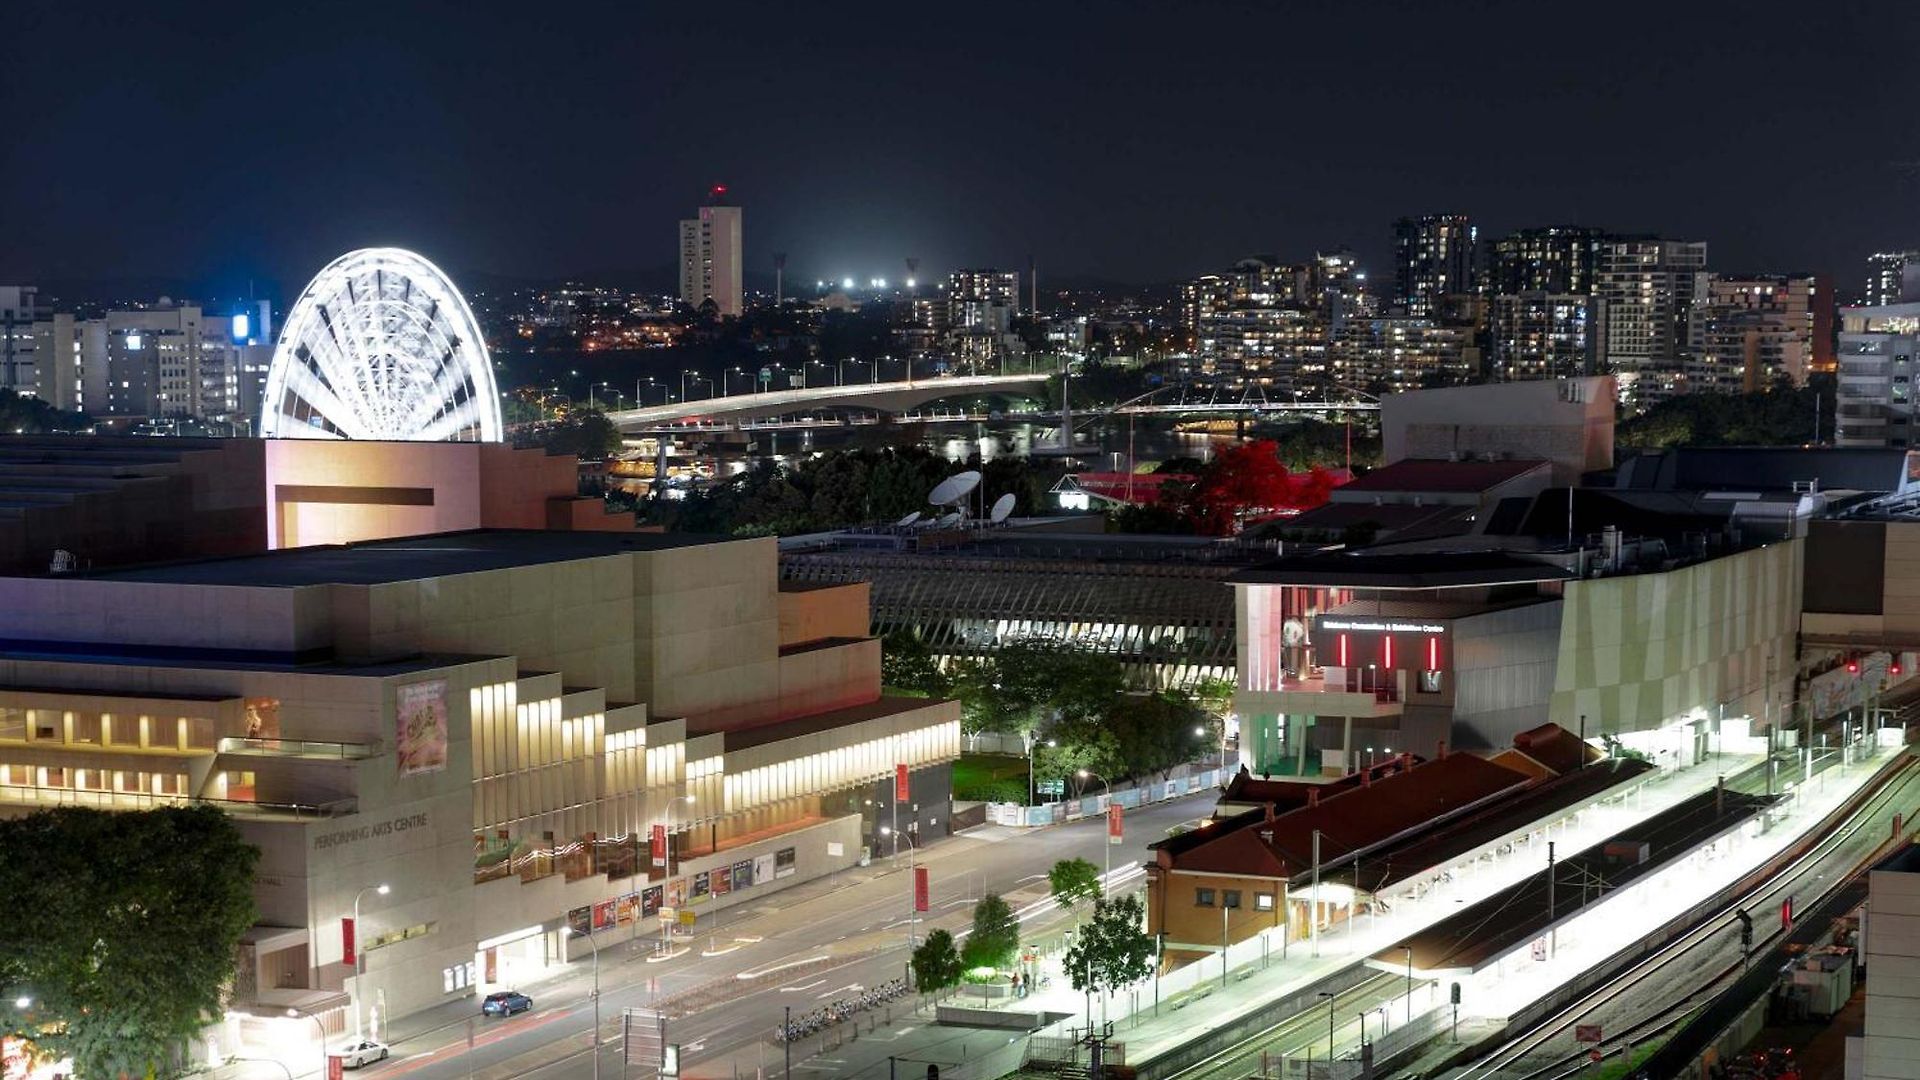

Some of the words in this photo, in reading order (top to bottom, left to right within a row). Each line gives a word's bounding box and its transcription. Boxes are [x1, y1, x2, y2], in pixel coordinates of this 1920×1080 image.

[313, 825, 369, 850] PERFORMING
[371, 820, 393, 838] ARTS
[394, 813, 427, 831] CENTRE
